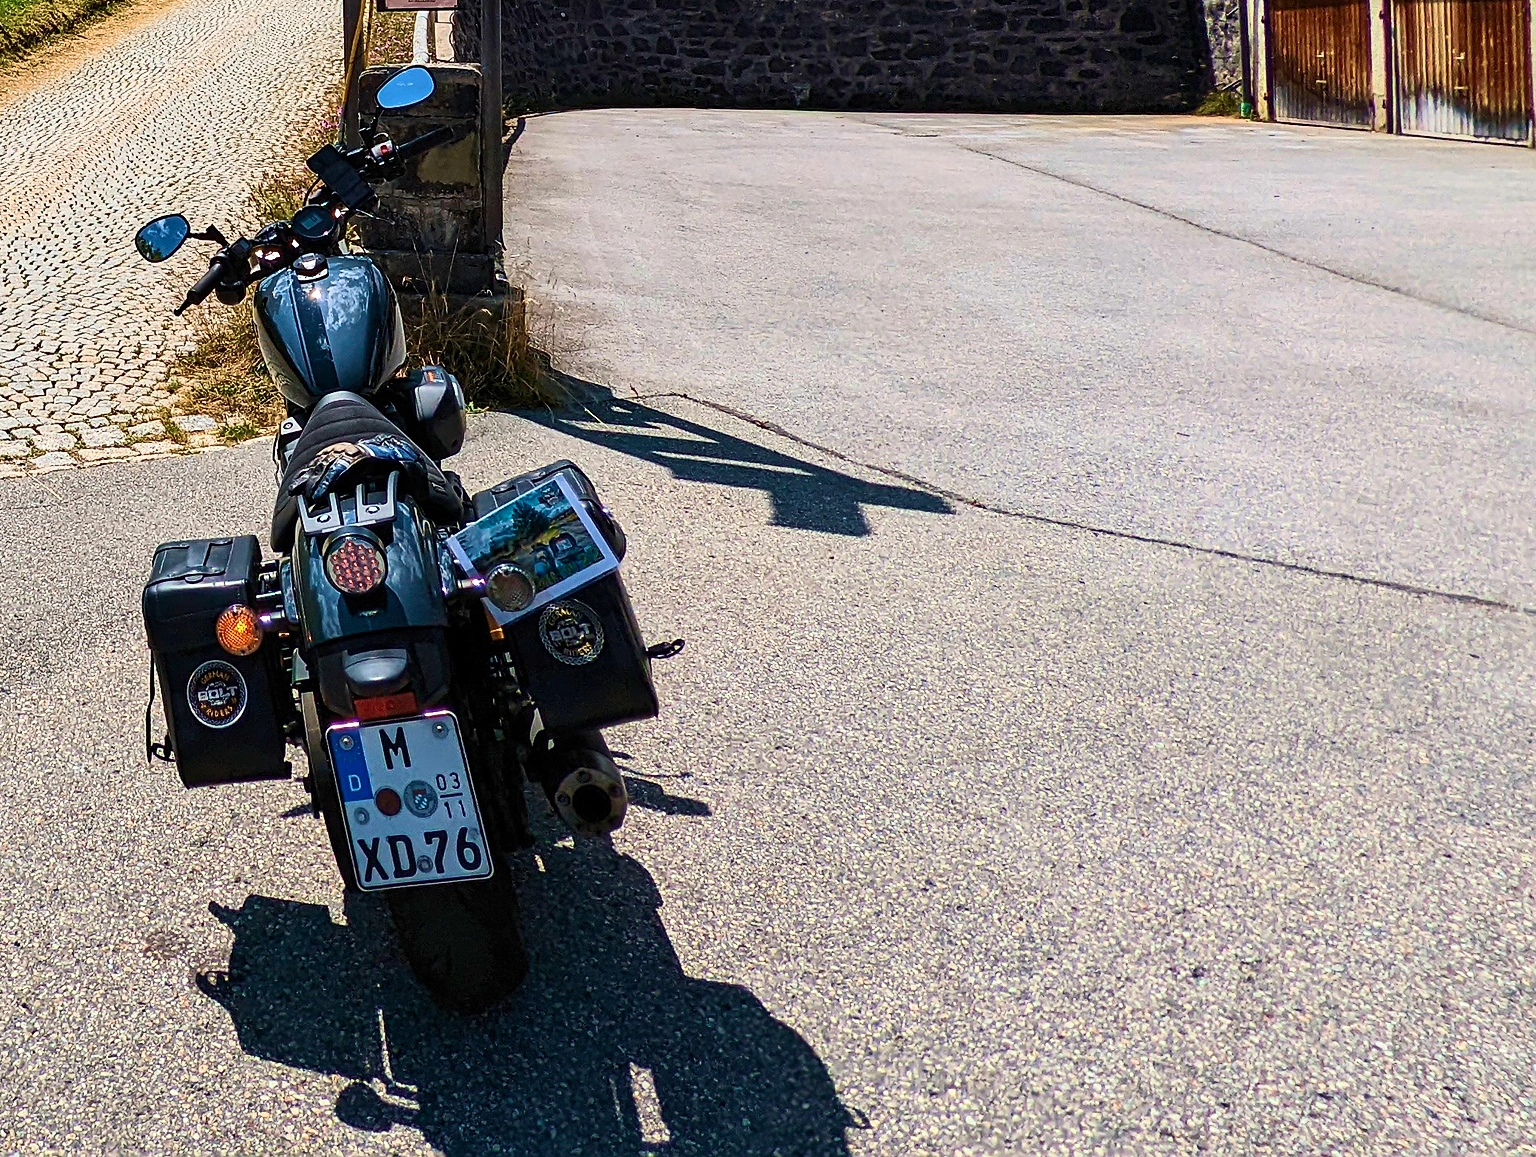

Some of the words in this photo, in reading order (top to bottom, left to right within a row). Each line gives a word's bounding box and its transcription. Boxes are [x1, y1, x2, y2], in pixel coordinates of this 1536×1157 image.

[549, 624, 591, 641] BOLT
[197, 686, 238, 701] BOLT
[206, 704, 233, 717] RIDERS
[379, 726, 411, 770] M
[348, 774, 362, 792] D
[435, 771, 461, 792] 03
[444, 799, 466, 819] 11
